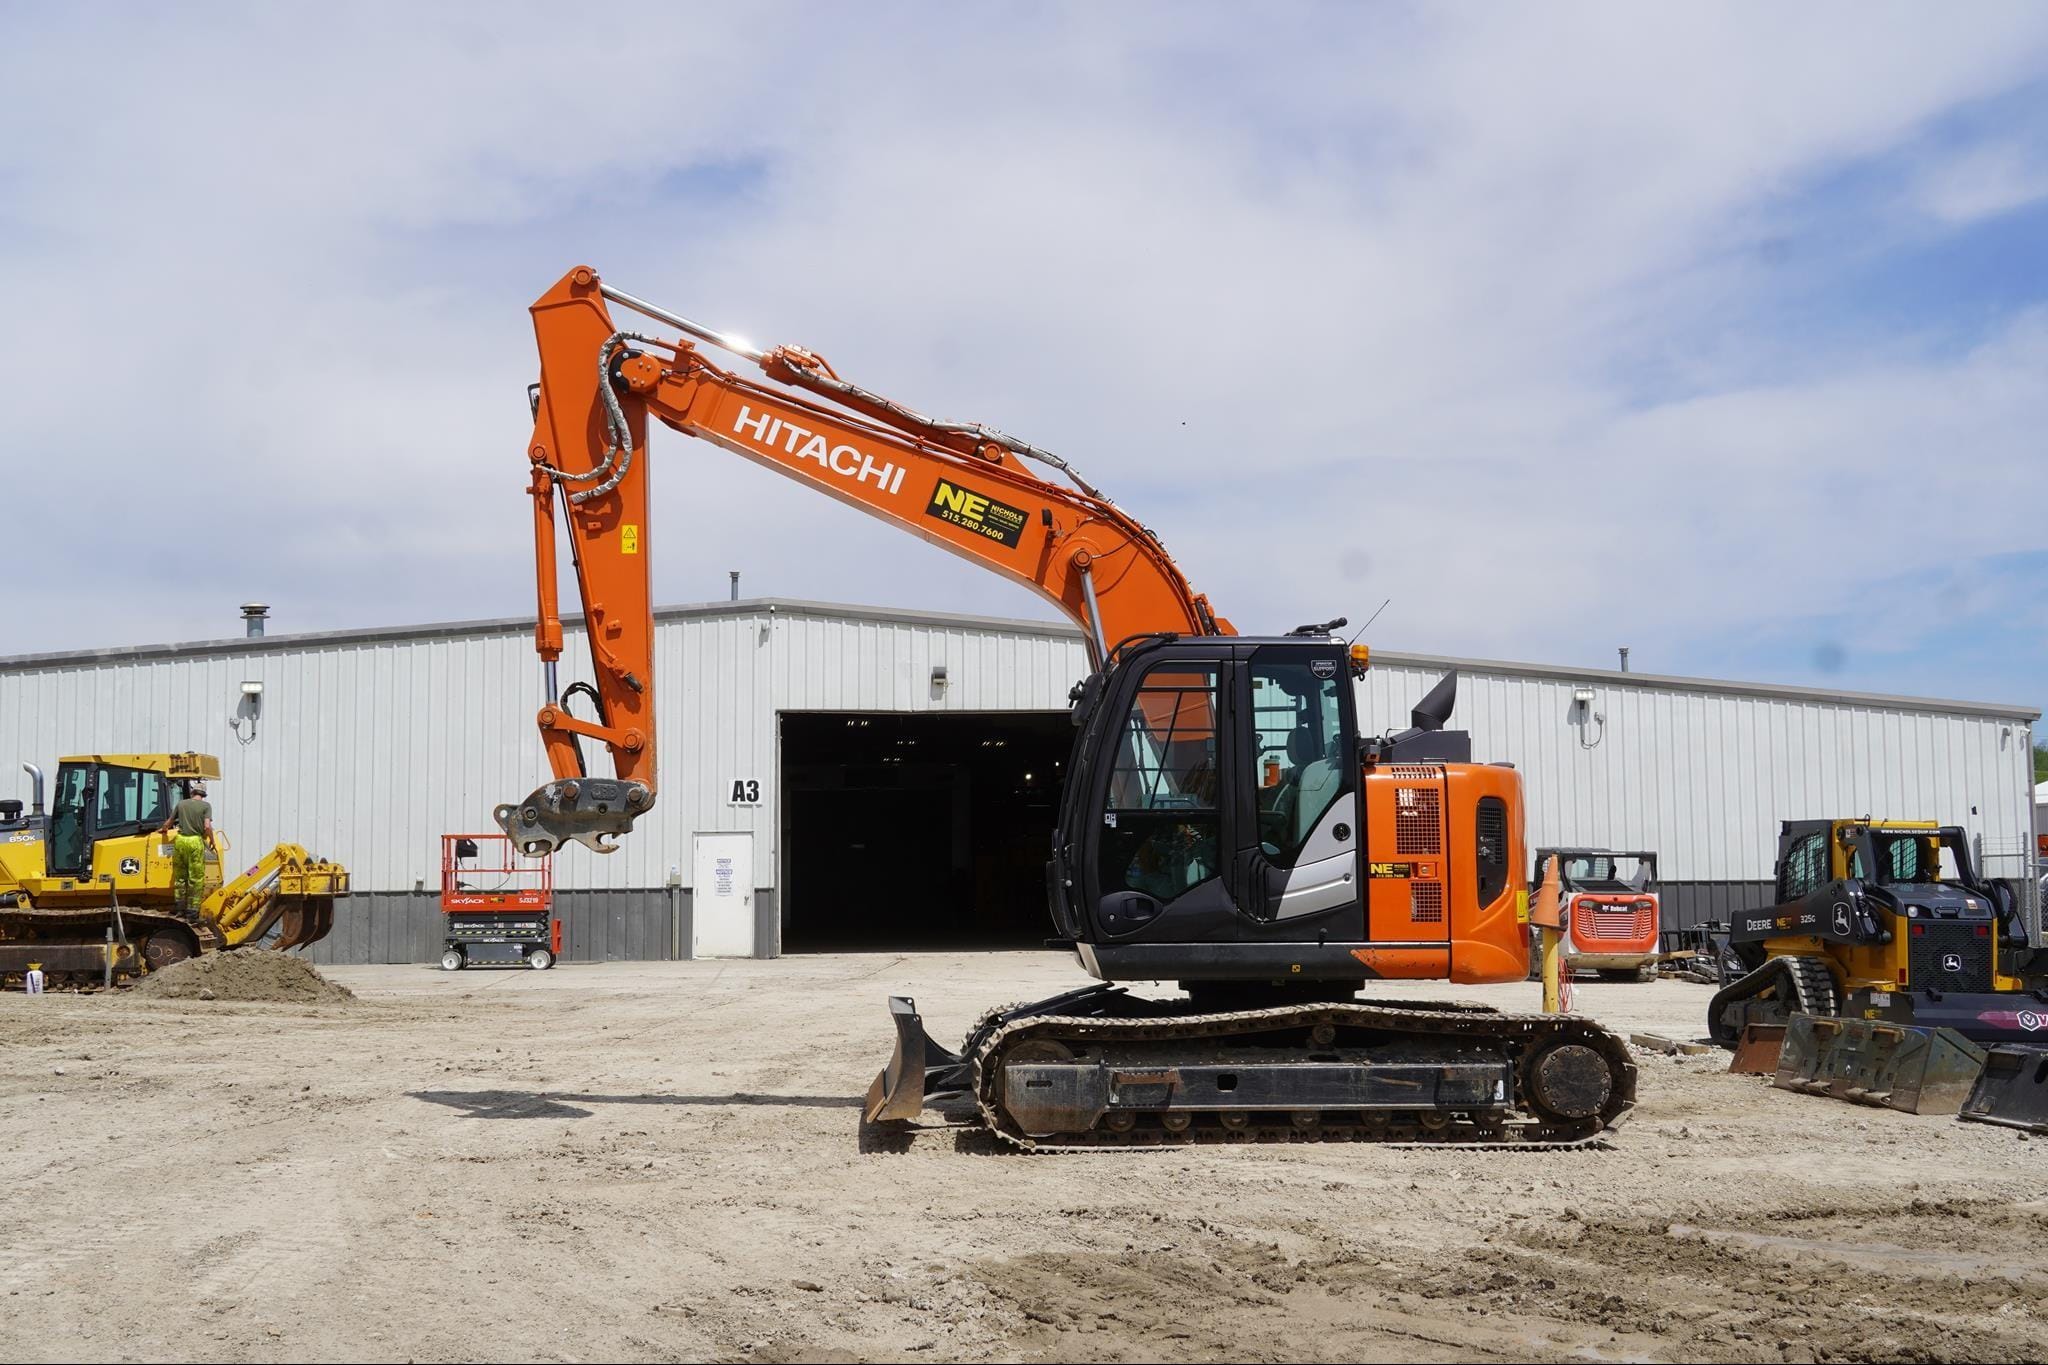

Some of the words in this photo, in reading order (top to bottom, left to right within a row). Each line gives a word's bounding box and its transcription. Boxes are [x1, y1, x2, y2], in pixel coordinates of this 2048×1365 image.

[733, 405, 906, 495] HITACHI
[934, 482, 990, 522] NE
[990, 504, 1024, 521] NICHOLS
[941, 510, 1004, 541] 515.280.7600
[732, 780, 759, 802] A3
[9, 835, 36, 843] 850K
[1370, 863, 1394, 874] NE
[450, 897, 485, 905] SKYJACK
[1746, 919, 1772, 932] DEERE
[1800, 915, 1816, 924] 325G
